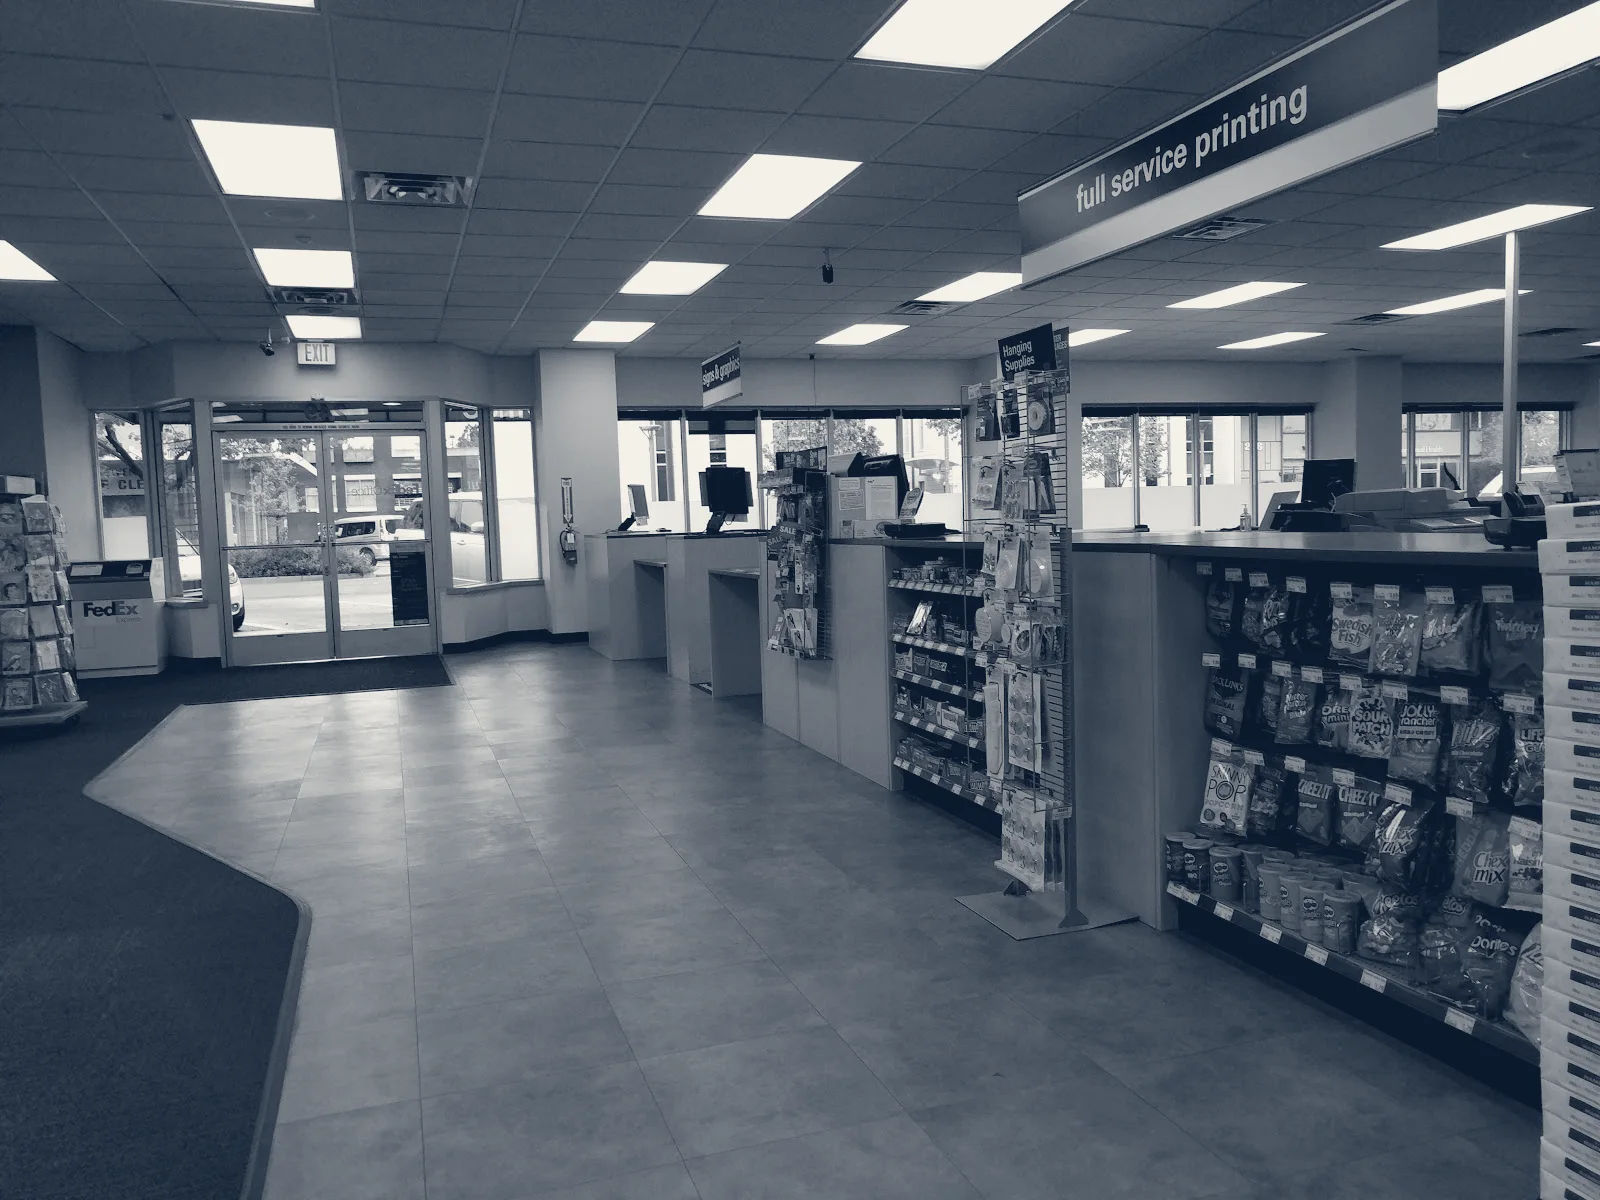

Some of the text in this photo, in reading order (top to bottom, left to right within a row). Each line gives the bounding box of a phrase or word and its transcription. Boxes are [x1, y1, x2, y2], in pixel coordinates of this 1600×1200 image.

[1076, 84, 1308, 213] full service printing
[304, 344, 330, 362] EXIT
[1002, 340, 1033, 358] Hanging
[703, 356, 740, 387] signs & graphics
[1004, 355, 1036, 372] Supplies
[779, 525, 797, 535] SALE
[768, 536, 783, 546] SALE
[83, 601, 139, 618] FedEx
[1331, 618, 1373, 637] Swedish
[1337, 629, 1362, 646] Fish
[1321, 705, 1349, 716] ORE
[1355, 708, 1389, 723] SOUR
[1400, 704, 1436, 718] JOLLY
[1352, 721, 1391, 736] PATCH
[1401, 716, 1436, 726] rancher
[1521, 729, 1544, 742] LIFE
[1211, 764, 1254, 785] SKINNY
[1207, 779, 1247, 803] POP
[1474, 852, 1508, 868] Chex
[1470, 935, 1519, 957] Doritos
